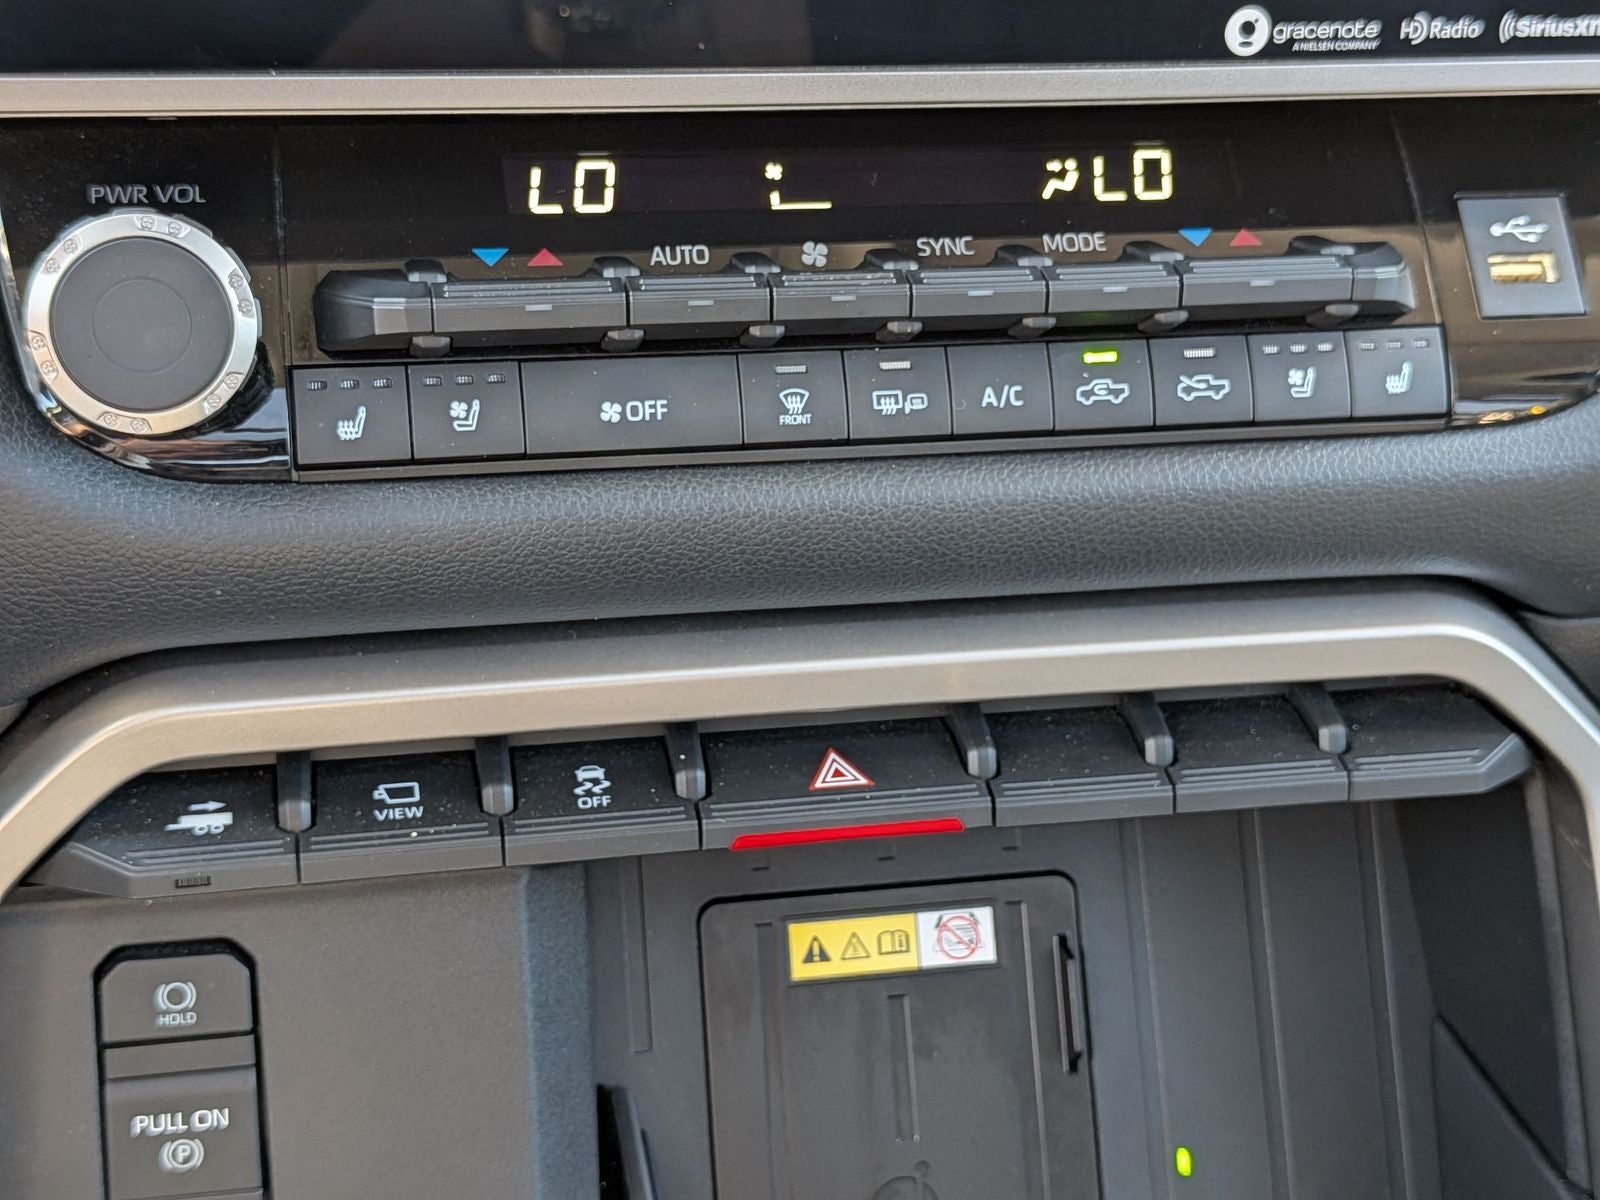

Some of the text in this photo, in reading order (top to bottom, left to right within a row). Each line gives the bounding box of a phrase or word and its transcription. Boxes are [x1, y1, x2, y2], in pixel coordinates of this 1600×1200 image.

[1273, 19, 1382, 44] gracenote
[1429, 16, 1484, 39] Radio
[1292, 39, 1381, 51] A NIELSEN COMPANY
[1094, 149, 1173, 201] LO
[87, 182, 206, 204] PWR VOL
[529, 159, 616, 215] LO
[916, 236, 975, 257] SYNC
[1043, 231, 1107, 253] MODE
[650, 245, 709, 266] AUTO
[981, 384, 1025, 409] A/C
[626, 399, 669, 422] OFF
[779, 413, 813, 426] FRONT
[577, 795, 612, 809] OFF
[373, 805, 424, 822] VIEW
[156, 1012, 198, 1028] HOLD
[130, 1107, 230, 1137] PULL ON
